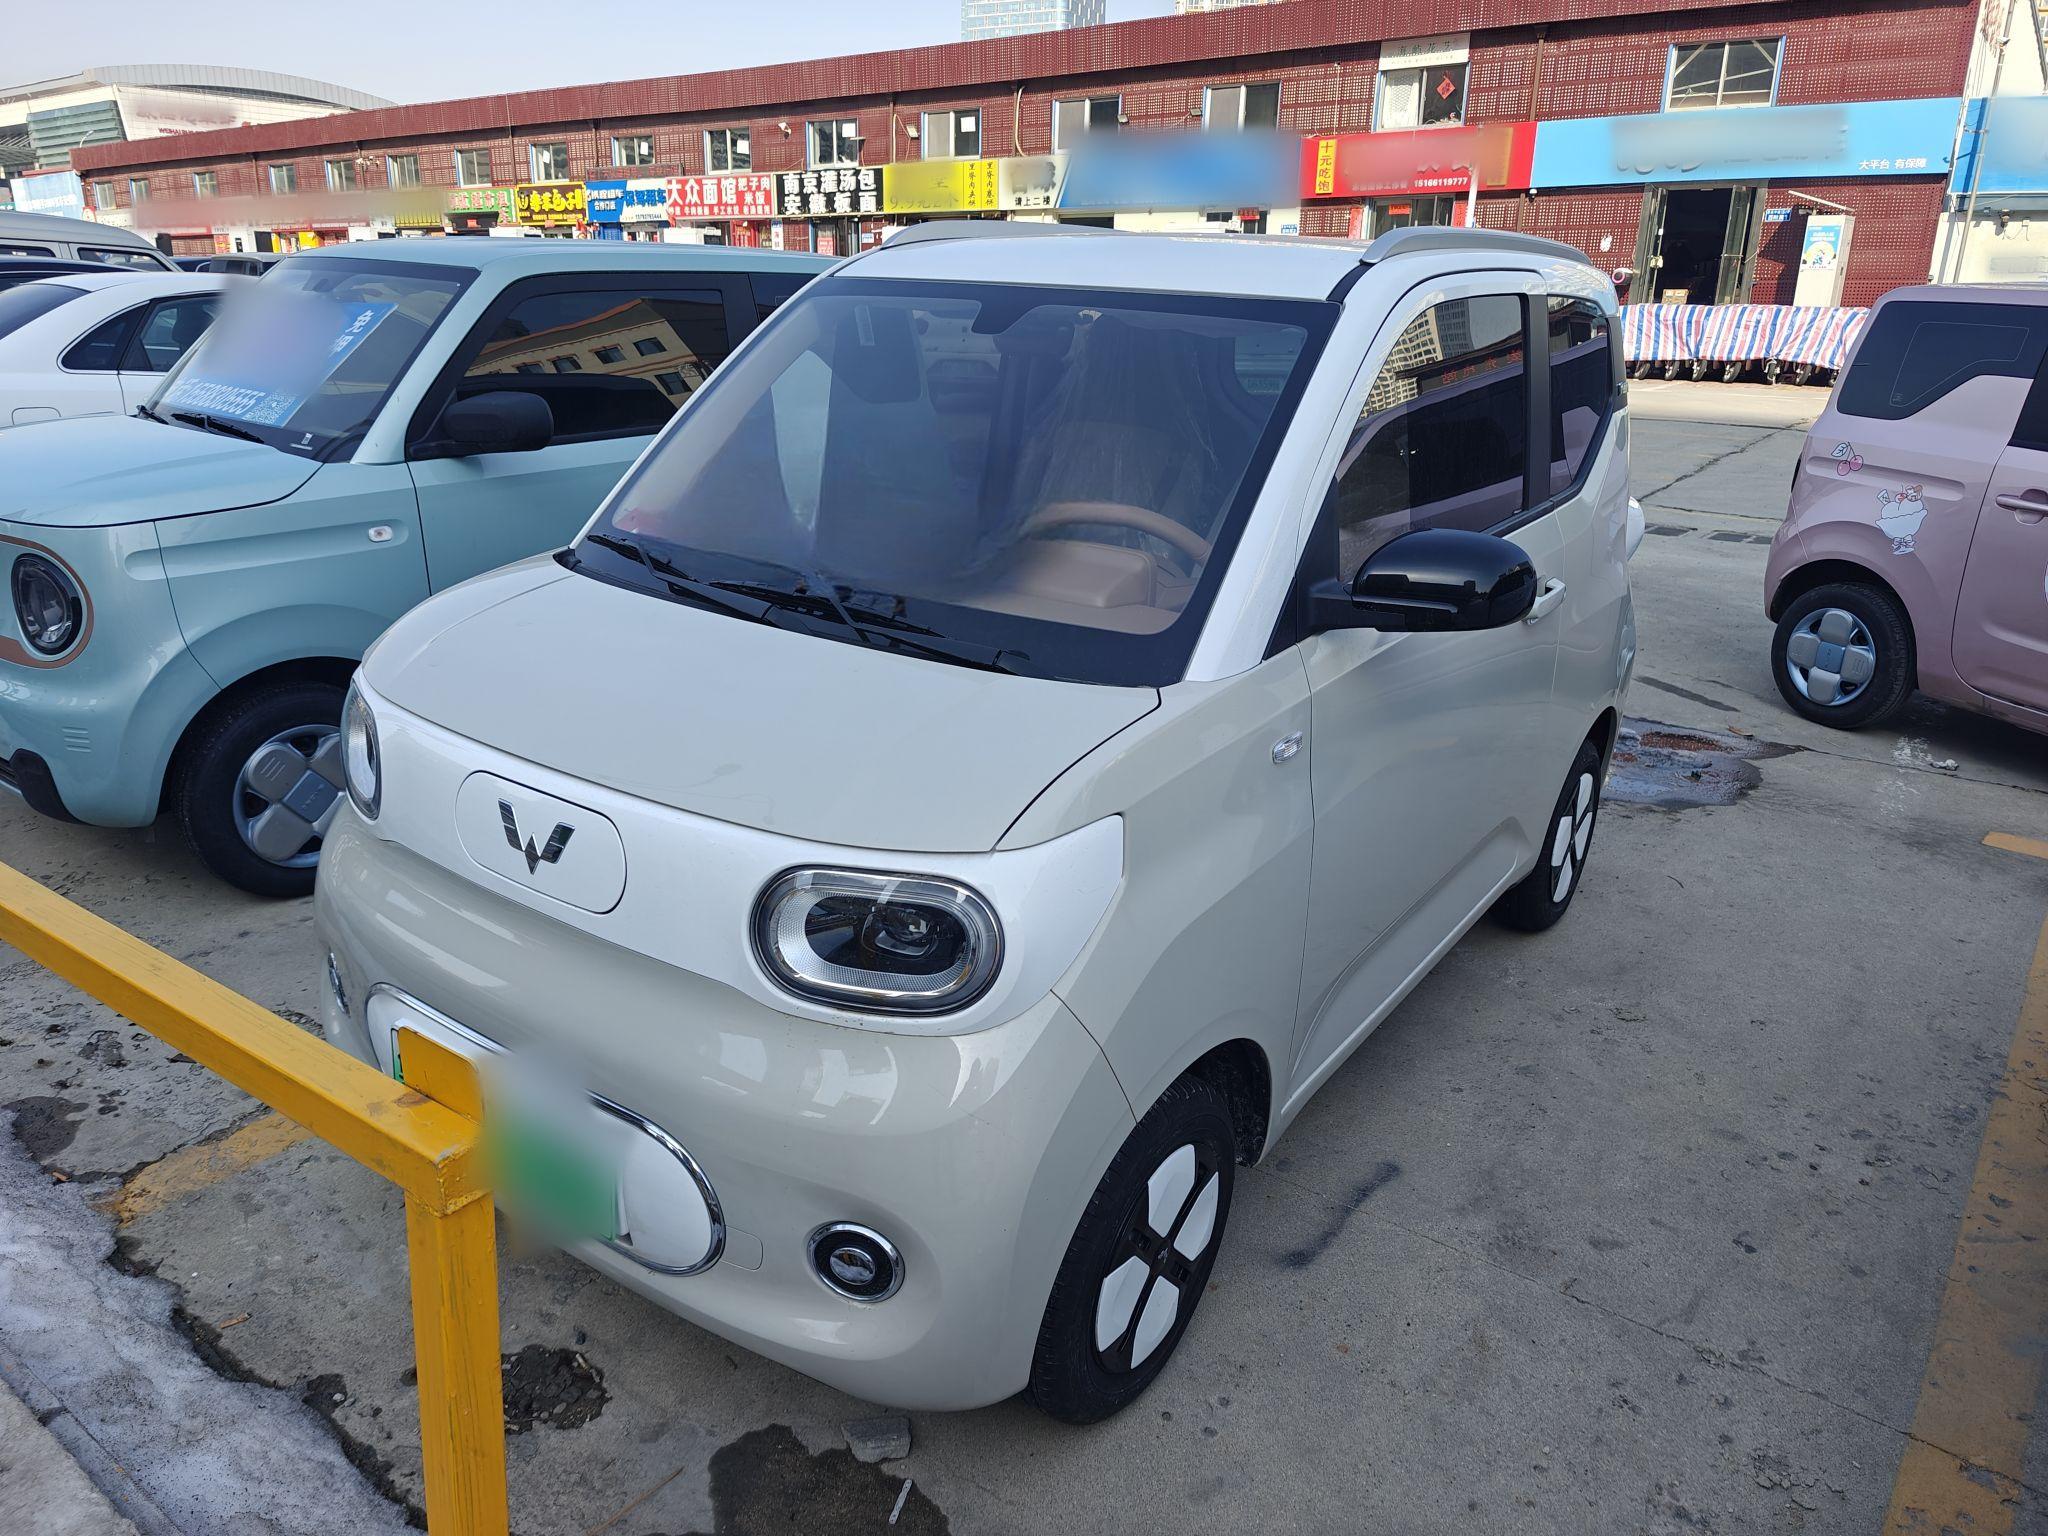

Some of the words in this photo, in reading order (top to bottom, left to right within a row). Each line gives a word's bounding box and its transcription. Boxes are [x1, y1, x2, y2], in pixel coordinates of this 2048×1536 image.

[1317, 141, 1334, 191] 十元吃饱
[1859, 159, 1889, 170] 大平台
[1894, 157, 1928, 169] 有保障
[667, 177, 737, 206] 大众面馆
[738, 176, 770, 192] 把子肉
[783, 169, 877, 195] 南京灌汤包
[1414, 176, 1468, 188] 15166119777
[743, 191, 766, 205] 米饭
[784, 191, 877, 216] 安徽板面
